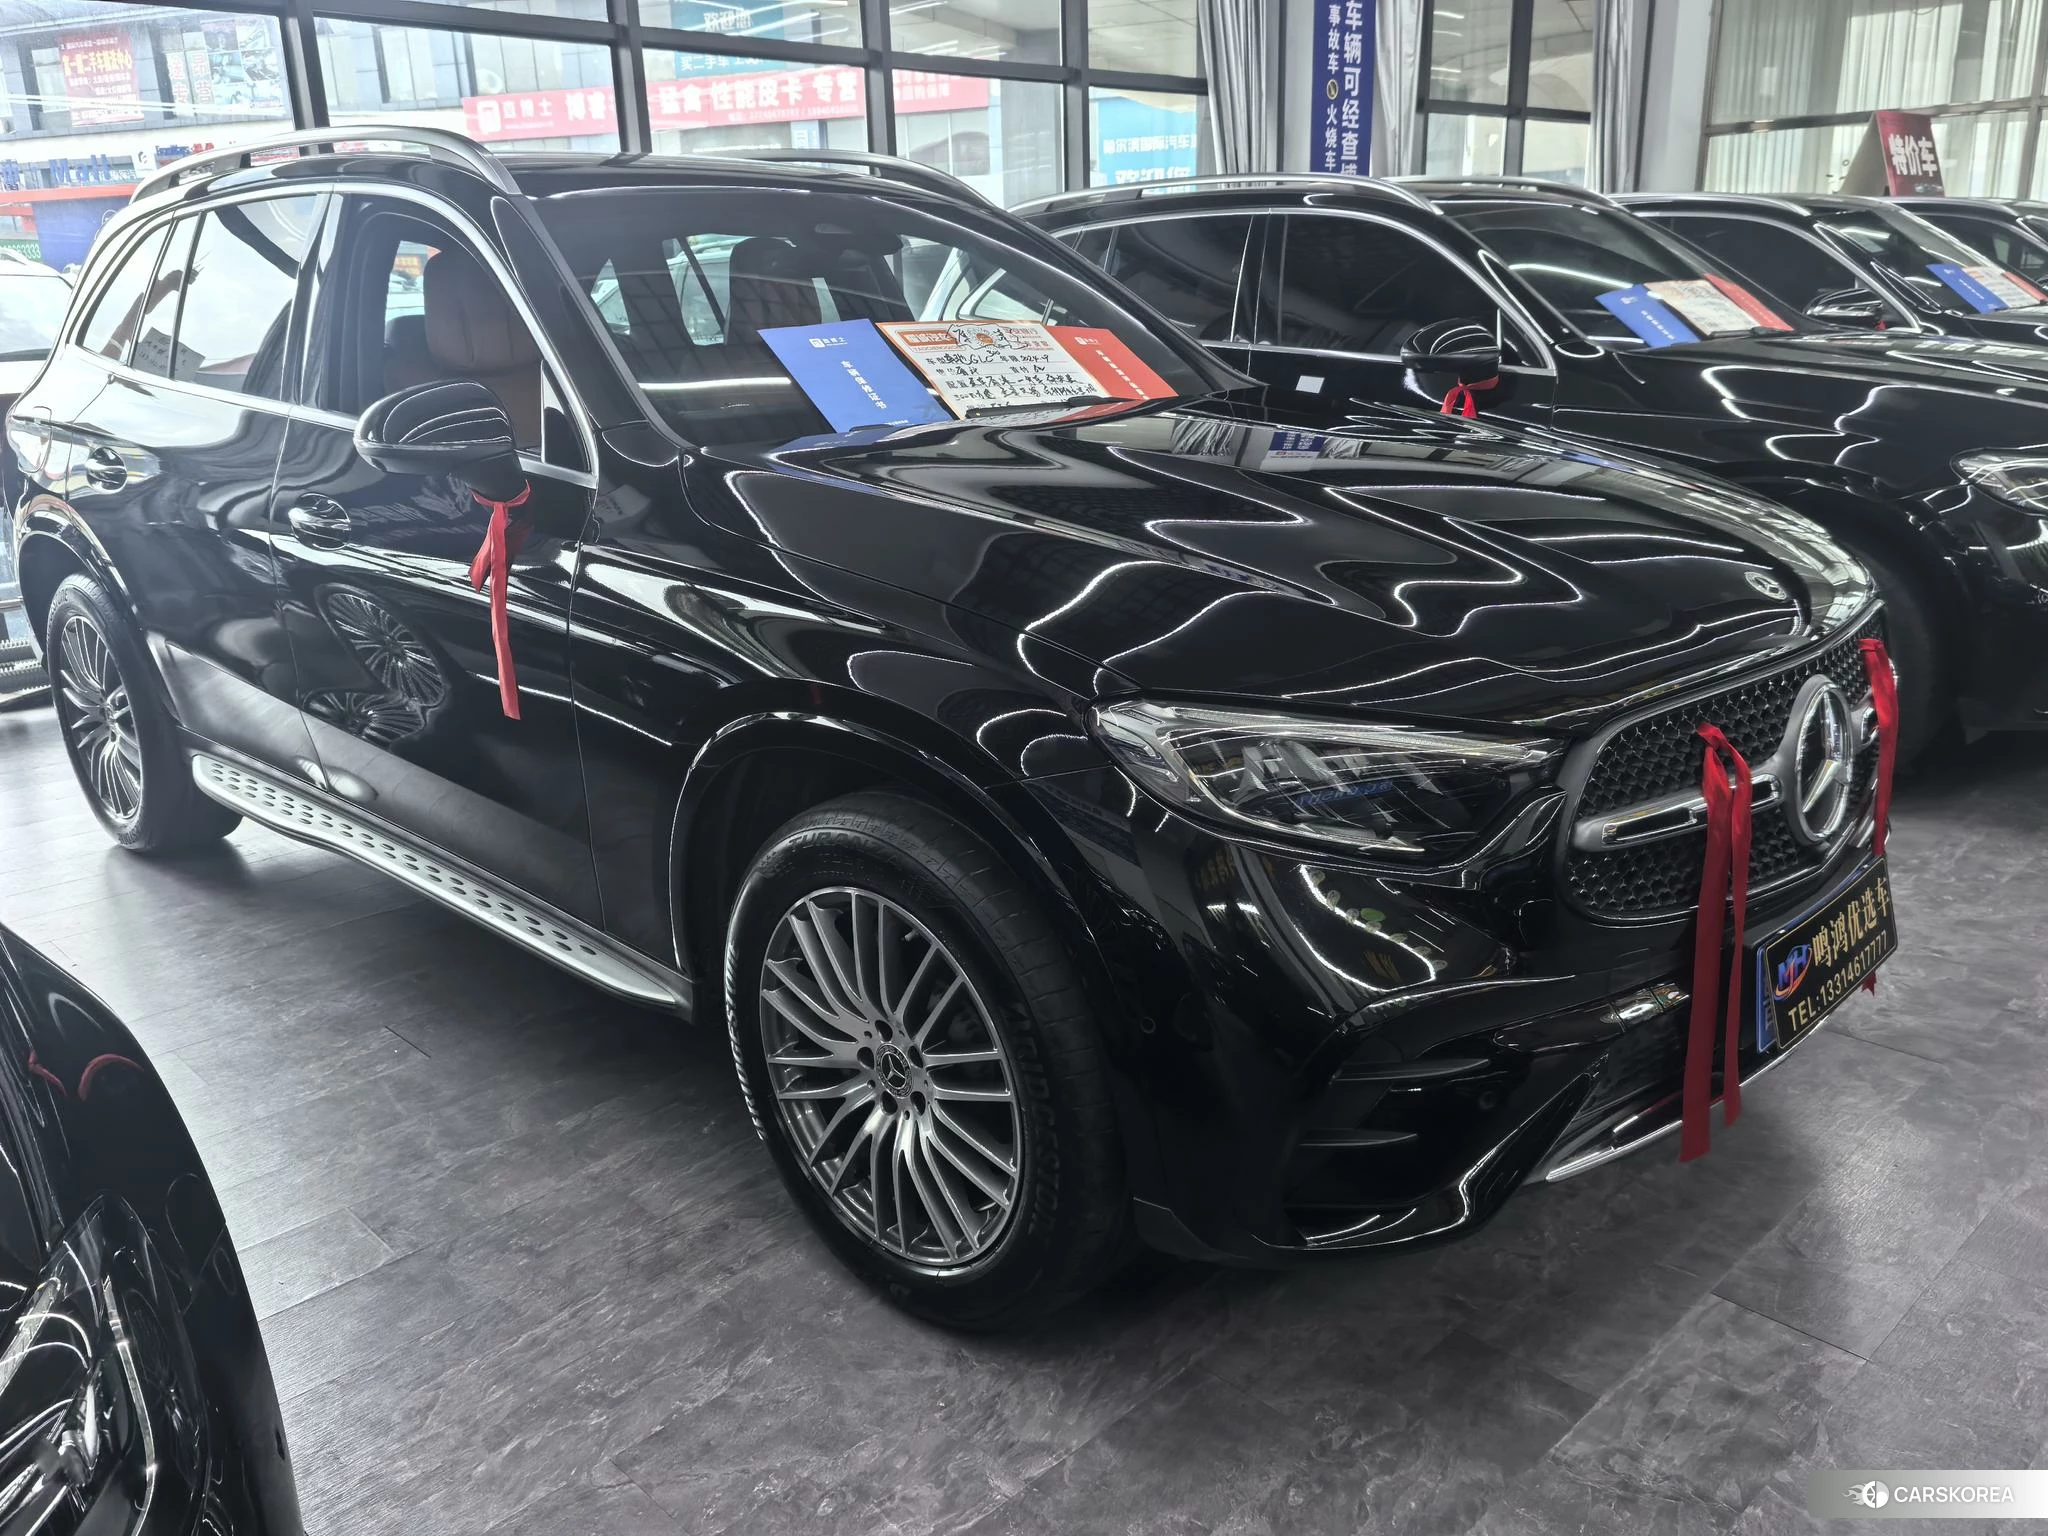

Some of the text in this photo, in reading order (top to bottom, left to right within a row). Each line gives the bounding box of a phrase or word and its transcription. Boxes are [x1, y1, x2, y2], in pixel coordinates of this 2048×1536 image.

[710, 77, 803, 111] 性能皮卡
[811, 71, 858, 103] 专营
[1325, 4, 1341, 172] 事故车 火烧车
[1888, 133, 1938, 177] 特价车
[1812, 877, 1889, 967] 鸣鸿优选车
